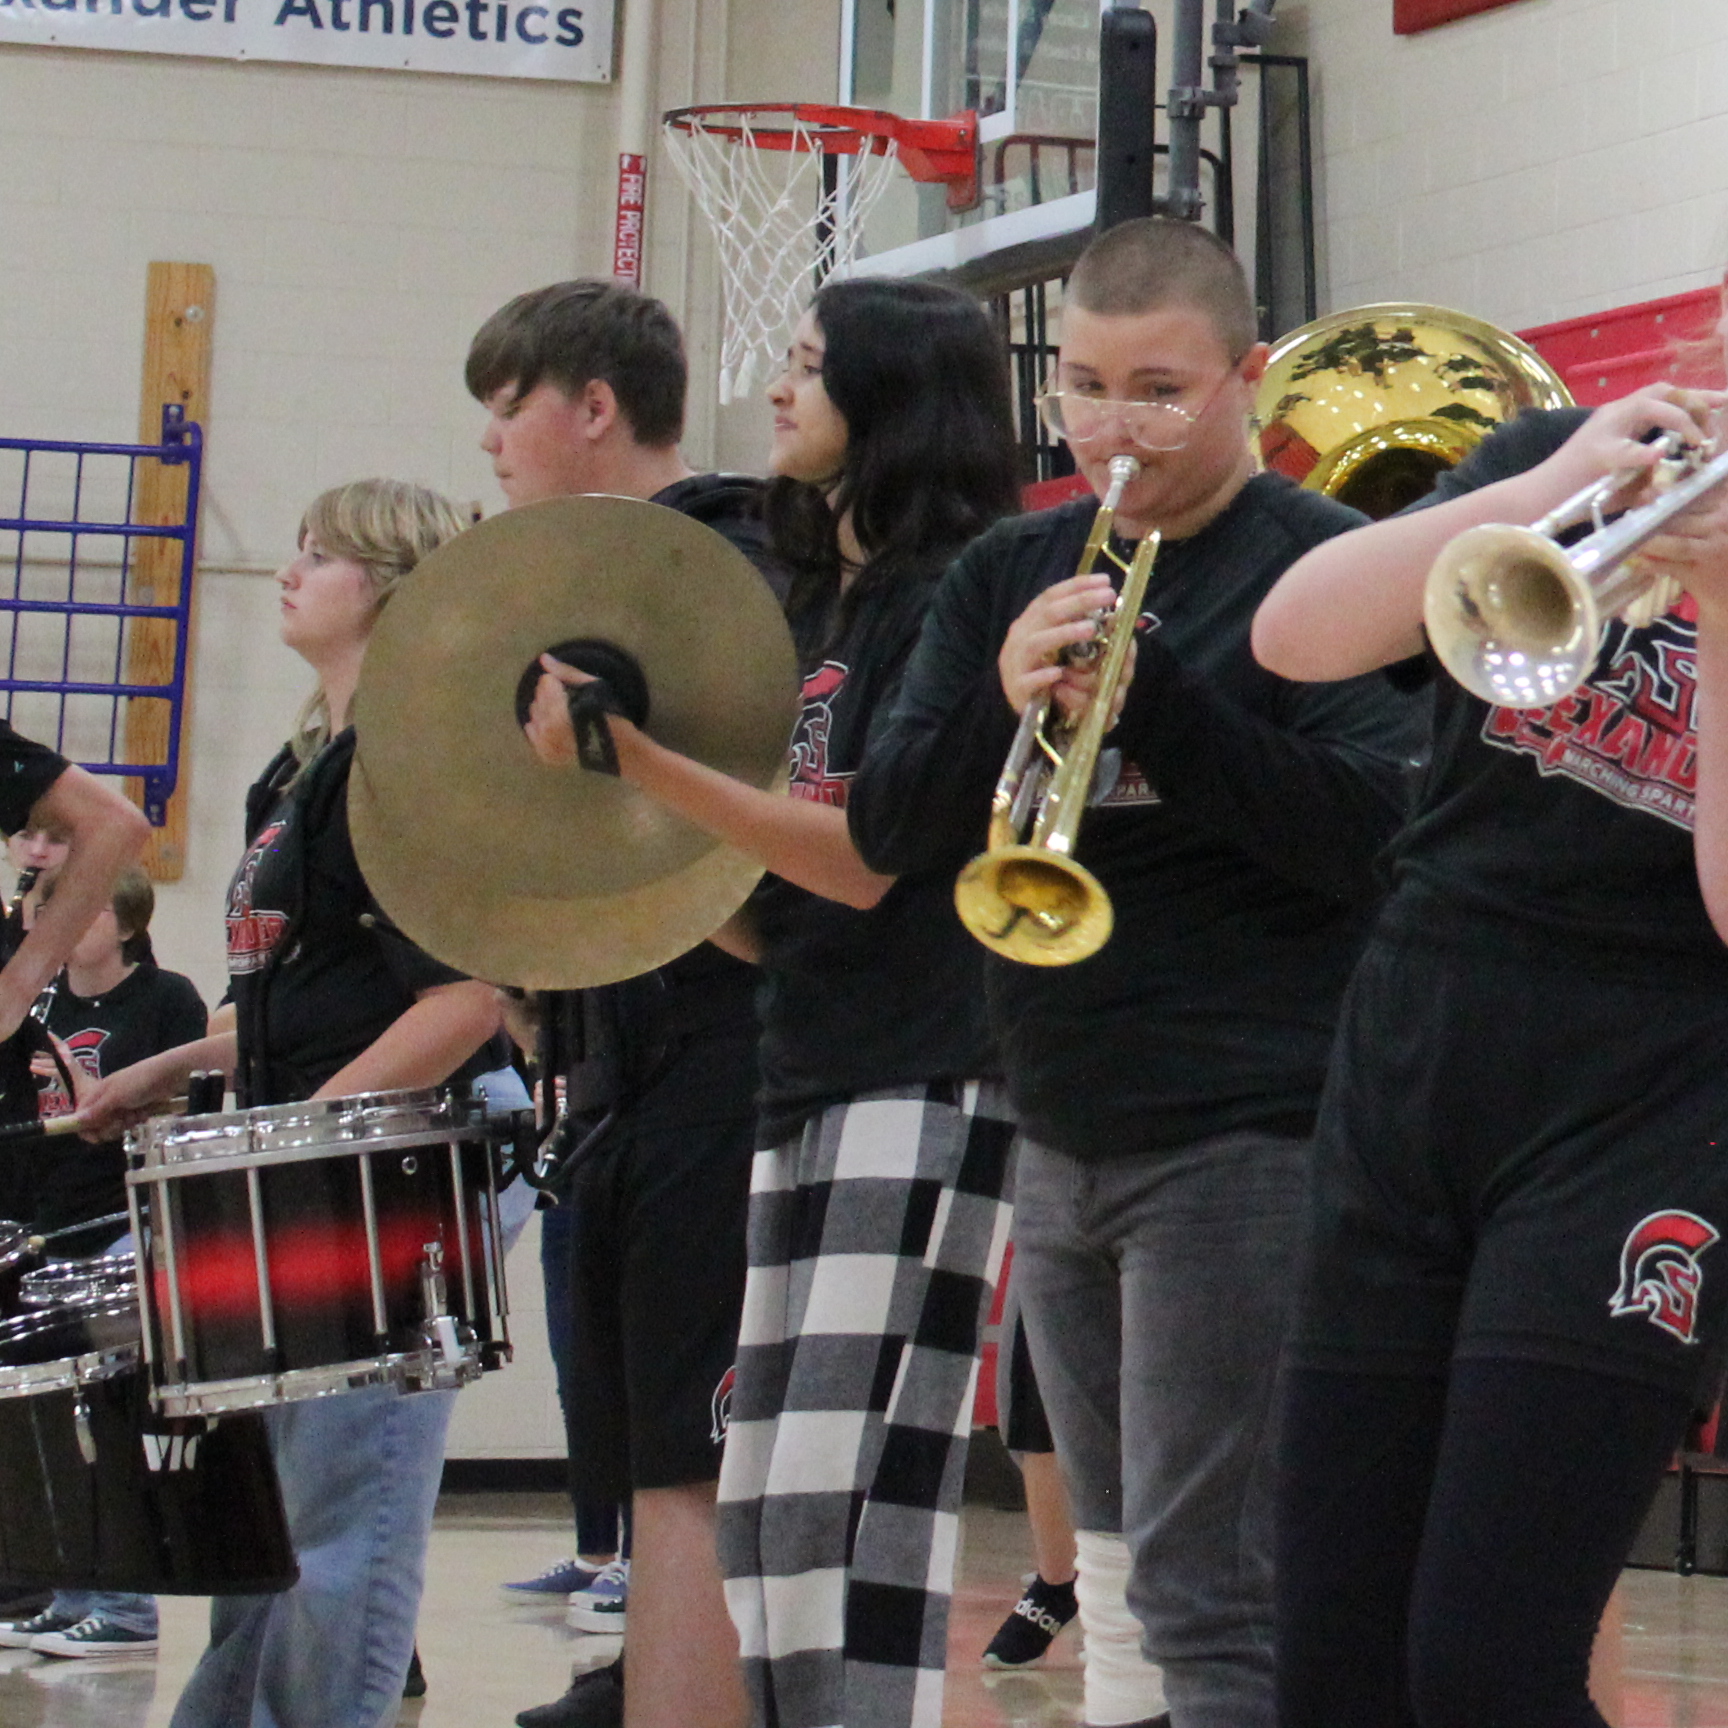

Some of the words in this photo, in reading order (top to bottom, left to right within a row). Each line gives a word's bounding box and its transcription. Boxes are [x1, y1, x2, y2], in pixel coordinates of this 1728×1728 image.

[621, 173, 643, 205] FIRE
[616, 211, 641, 278] PROTECT
[1561, 747, 1638, 799] MARCHING
[1640, 785, 1698, 819] SPART
